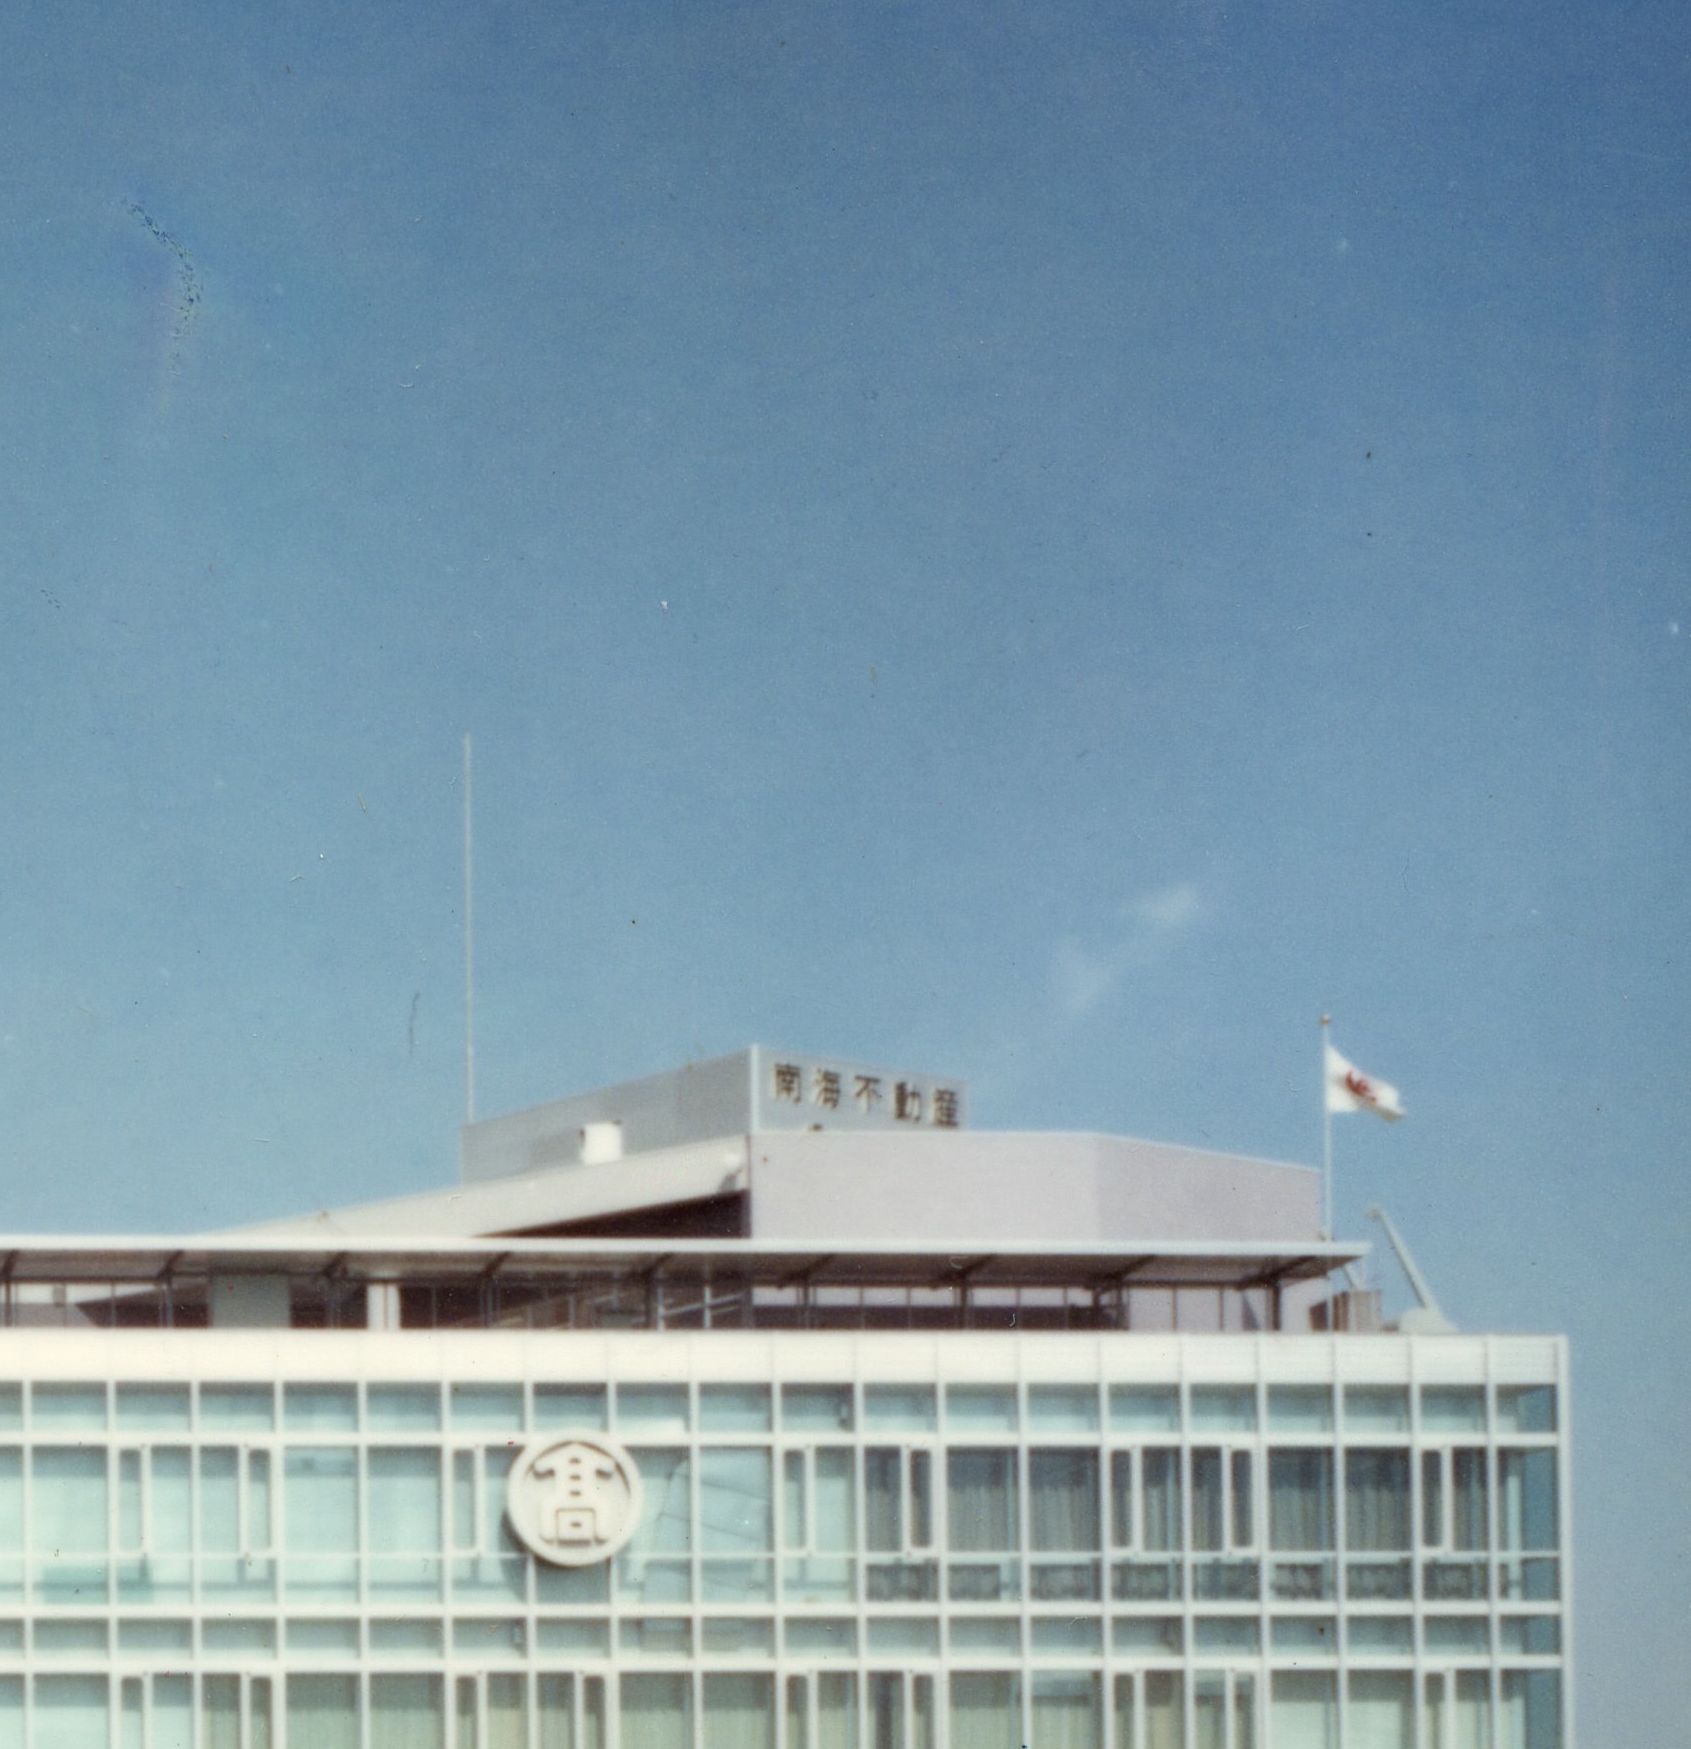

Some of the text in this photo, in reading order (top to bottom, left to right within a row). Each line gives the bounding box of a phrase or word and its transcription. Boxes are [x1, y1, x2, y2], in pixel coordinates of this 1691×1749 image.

[773, 1062, 959, 1129] 南海不動産
